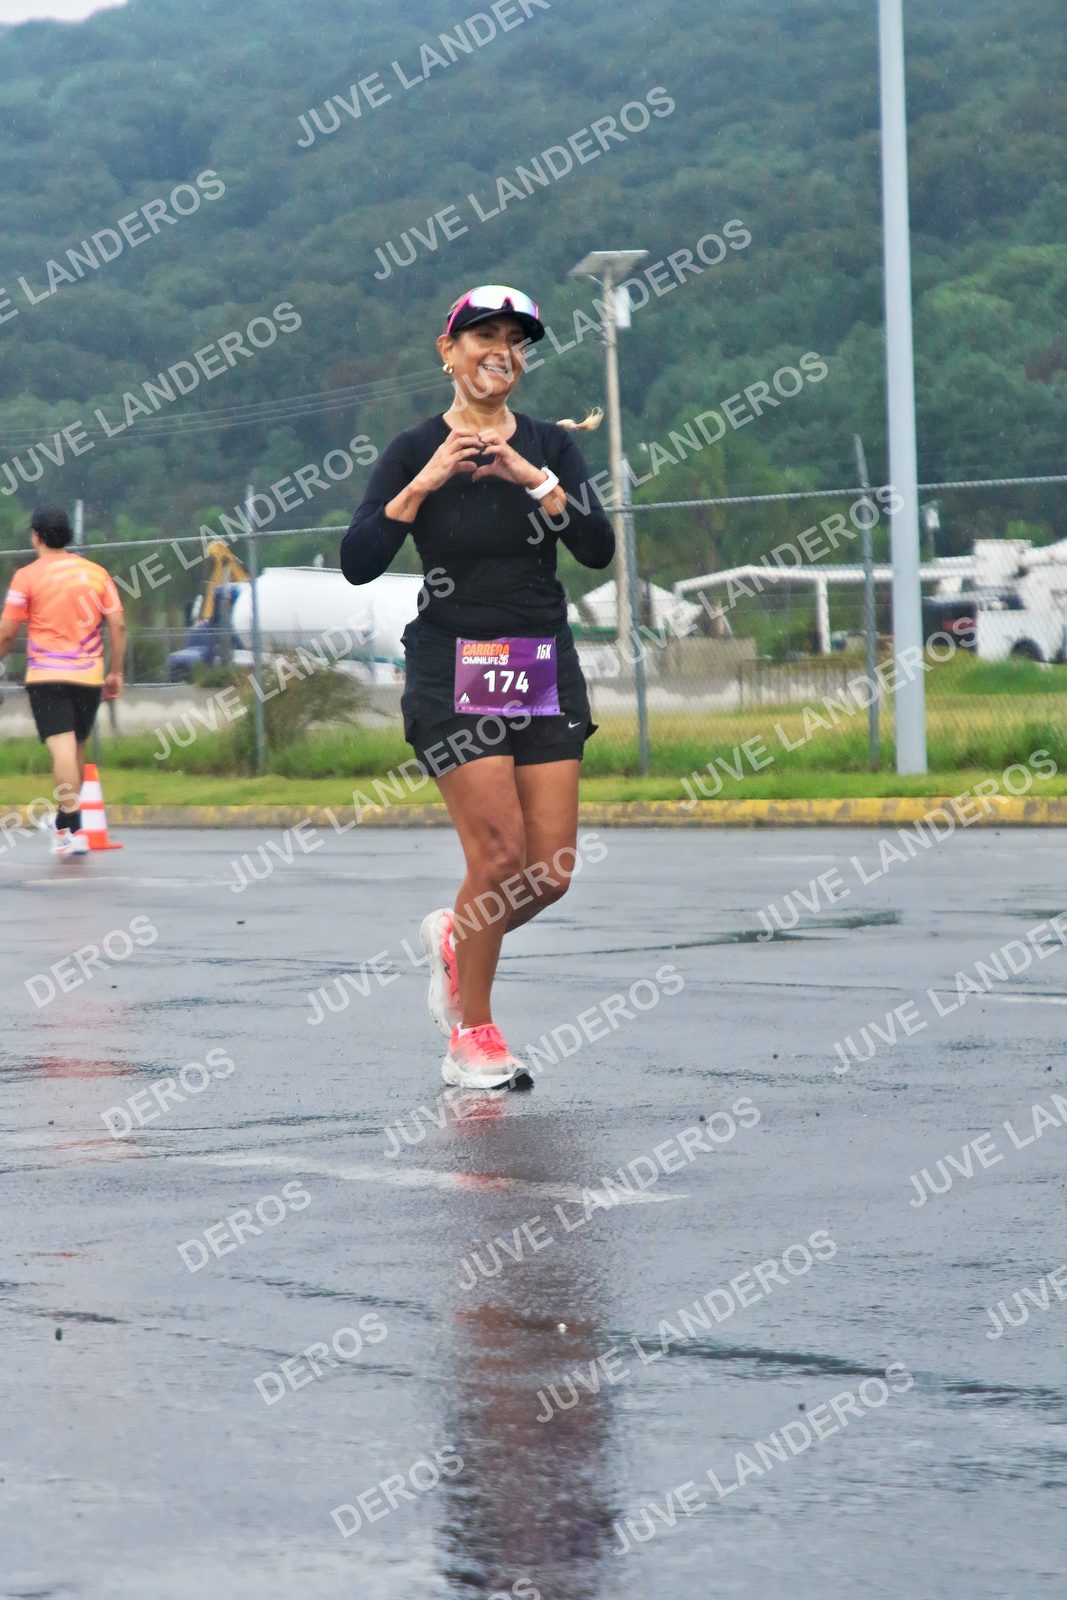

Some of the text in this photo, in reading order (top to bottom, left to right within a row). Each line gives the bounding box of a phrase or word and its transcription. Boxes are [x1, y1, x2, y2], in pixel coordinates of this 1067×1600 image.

[463, 642, 509, 656] CARRERA
[462, 656, 498, 665] OMNILIFE
[484, 670, 529, 693] 174
